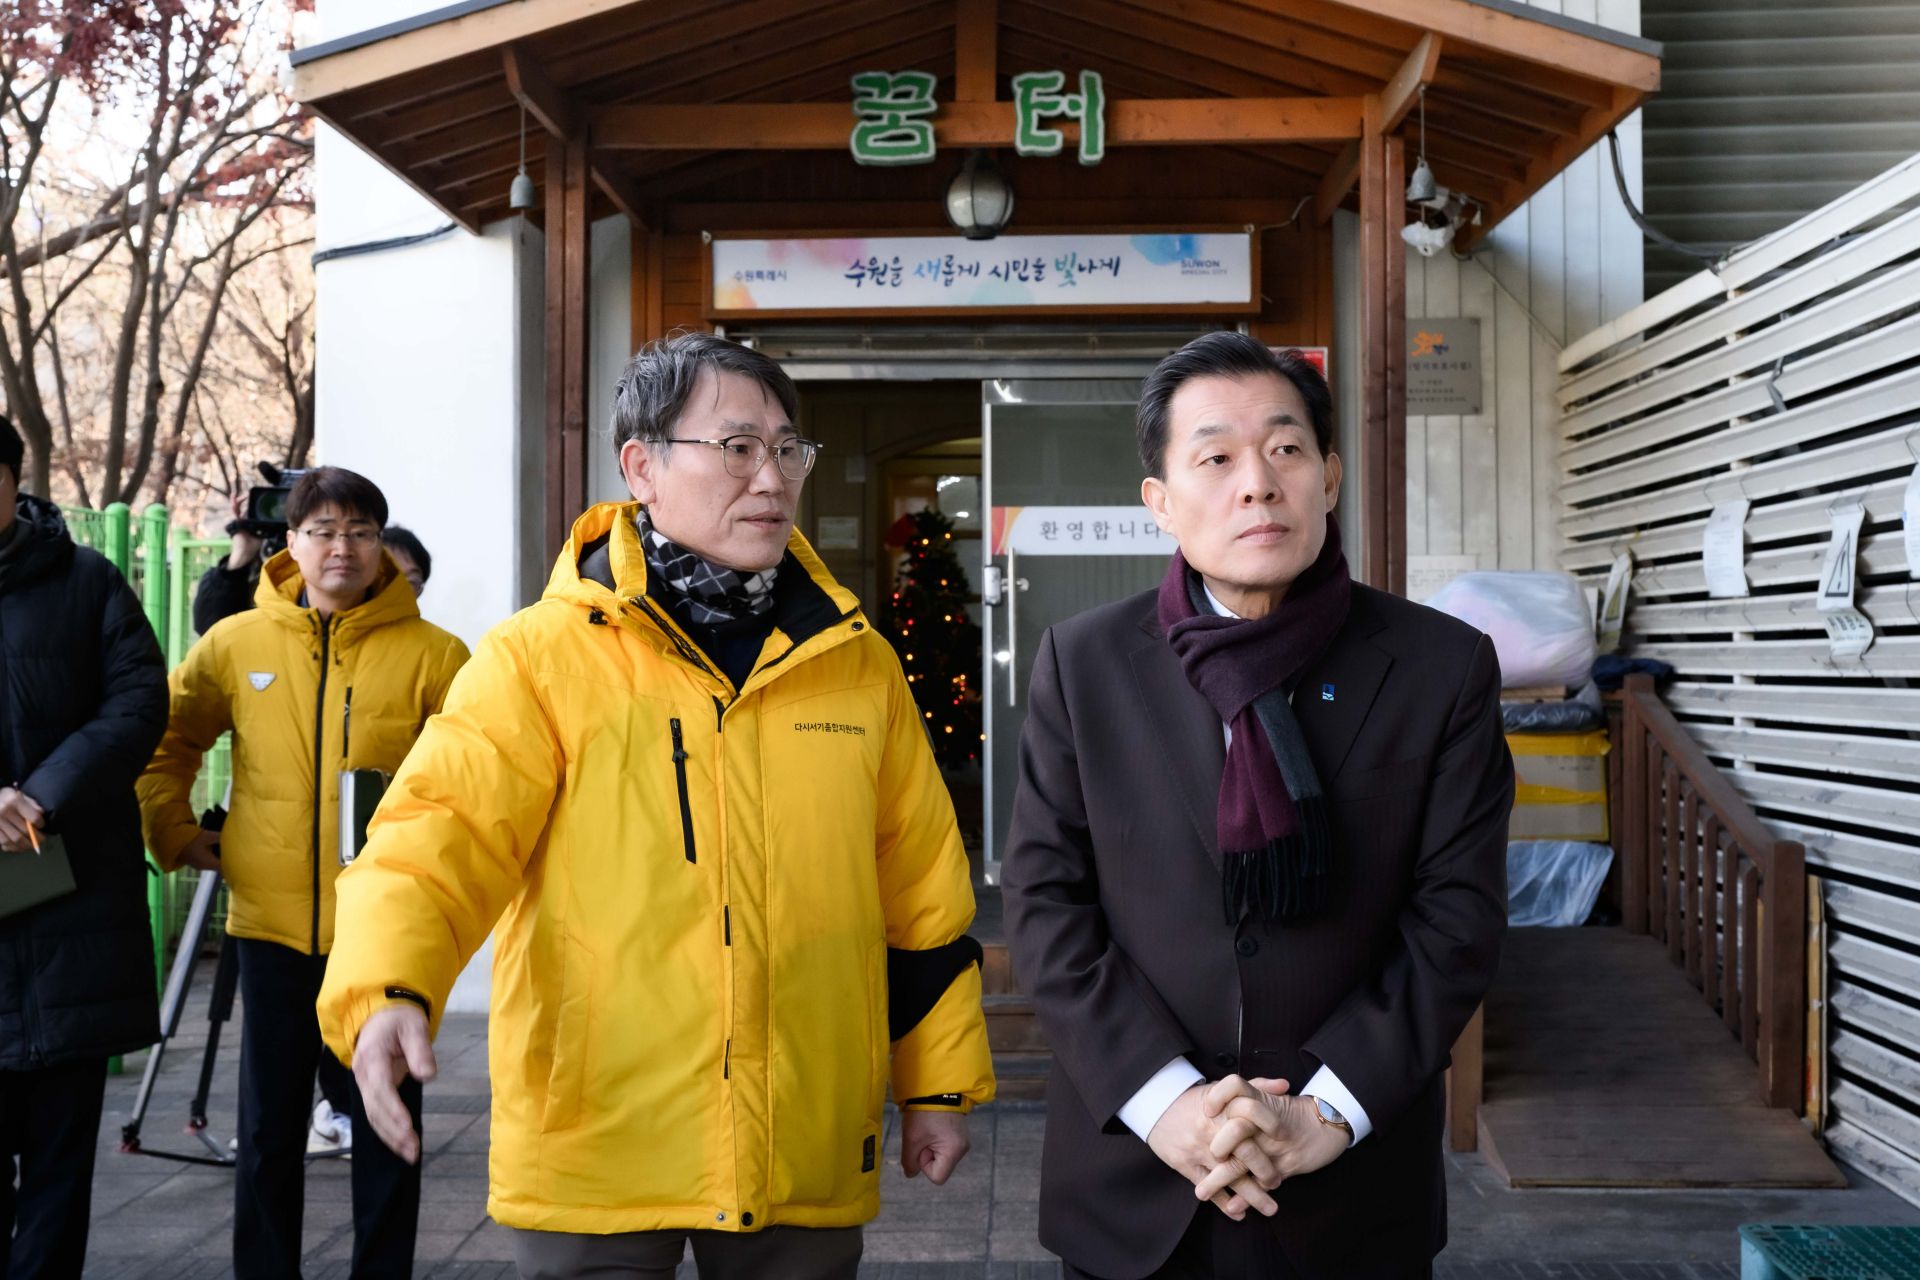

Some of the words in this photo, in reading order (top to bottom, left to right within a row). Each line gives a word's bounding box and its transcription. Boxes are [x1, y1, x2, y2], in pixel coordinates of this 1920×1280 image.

[844, 256, 903, 288] 수원을
[913, 254, 980, 287] 새롭게
[988, 257, 1046, 282] 시민을
[1054, 252, 1120, 287] 빛나게
[794, 722, 866, 736] 다시서기종합지원센터
